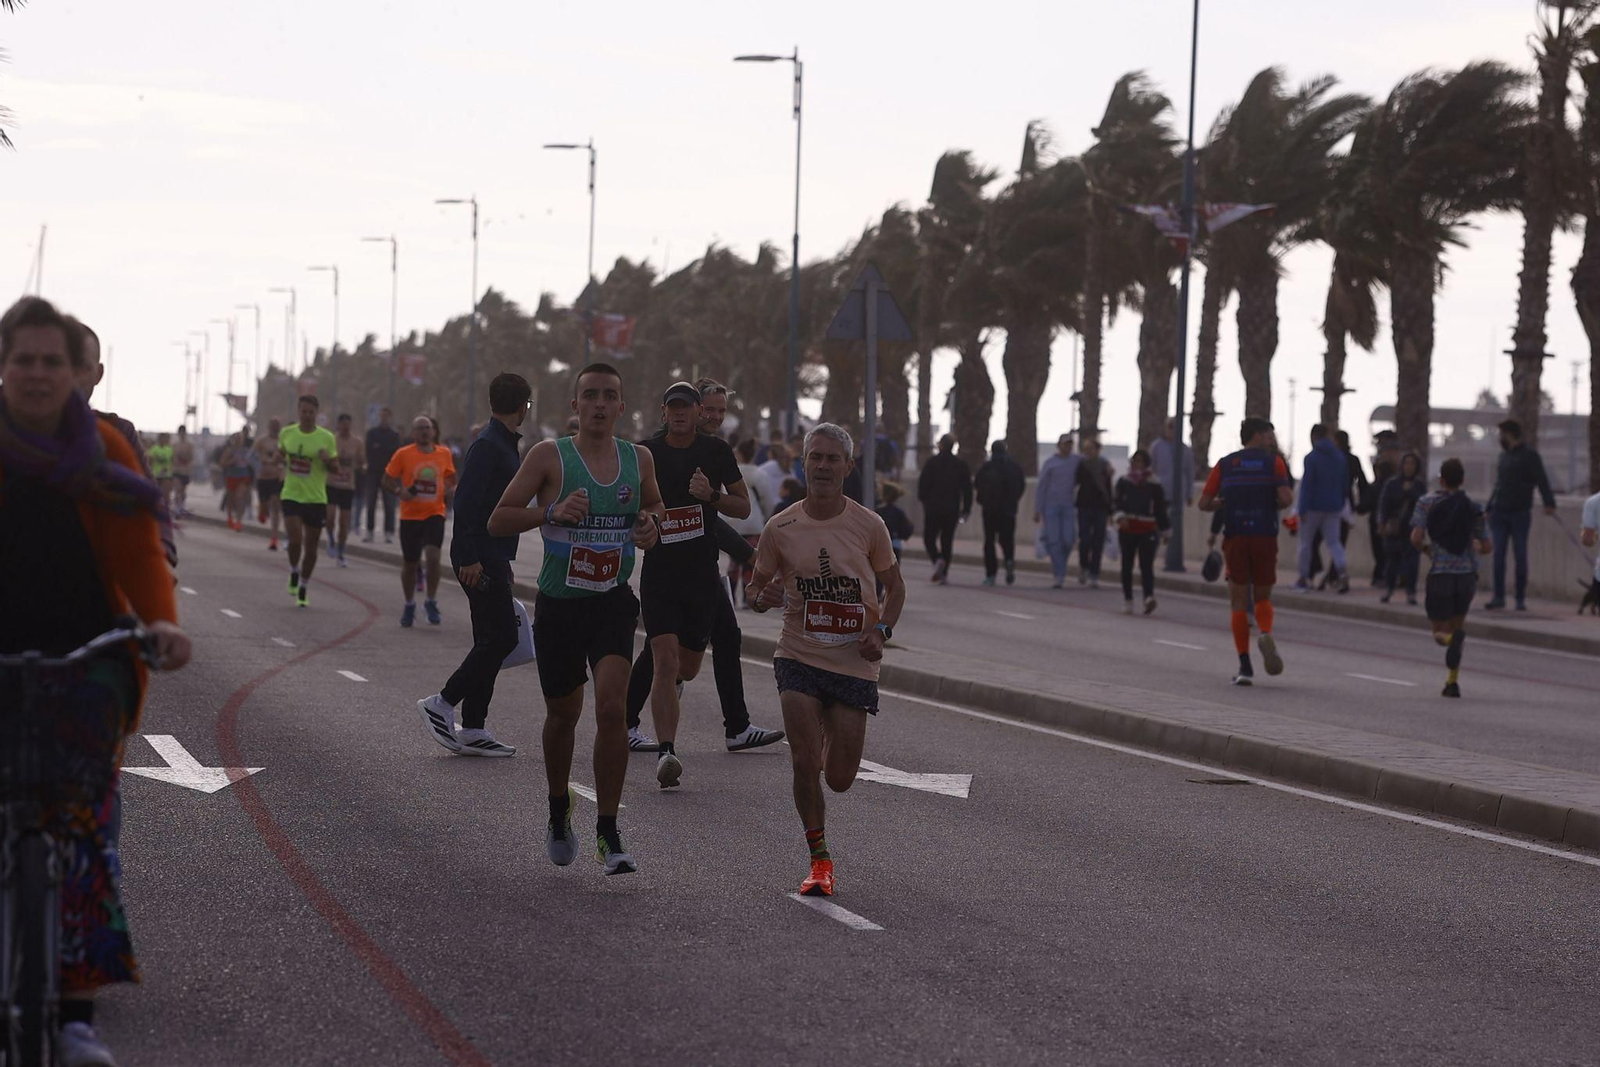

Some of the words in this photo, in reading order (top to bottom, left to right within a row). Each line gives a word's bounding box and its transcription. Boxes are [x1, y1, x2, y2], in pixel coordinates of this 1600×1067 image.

[679, 516, 701, 527] 1343
[602, 563, 612, 575] 91
[795, 575, 862, 594] BRUNCH
[837, 618, 857, 628] 140
